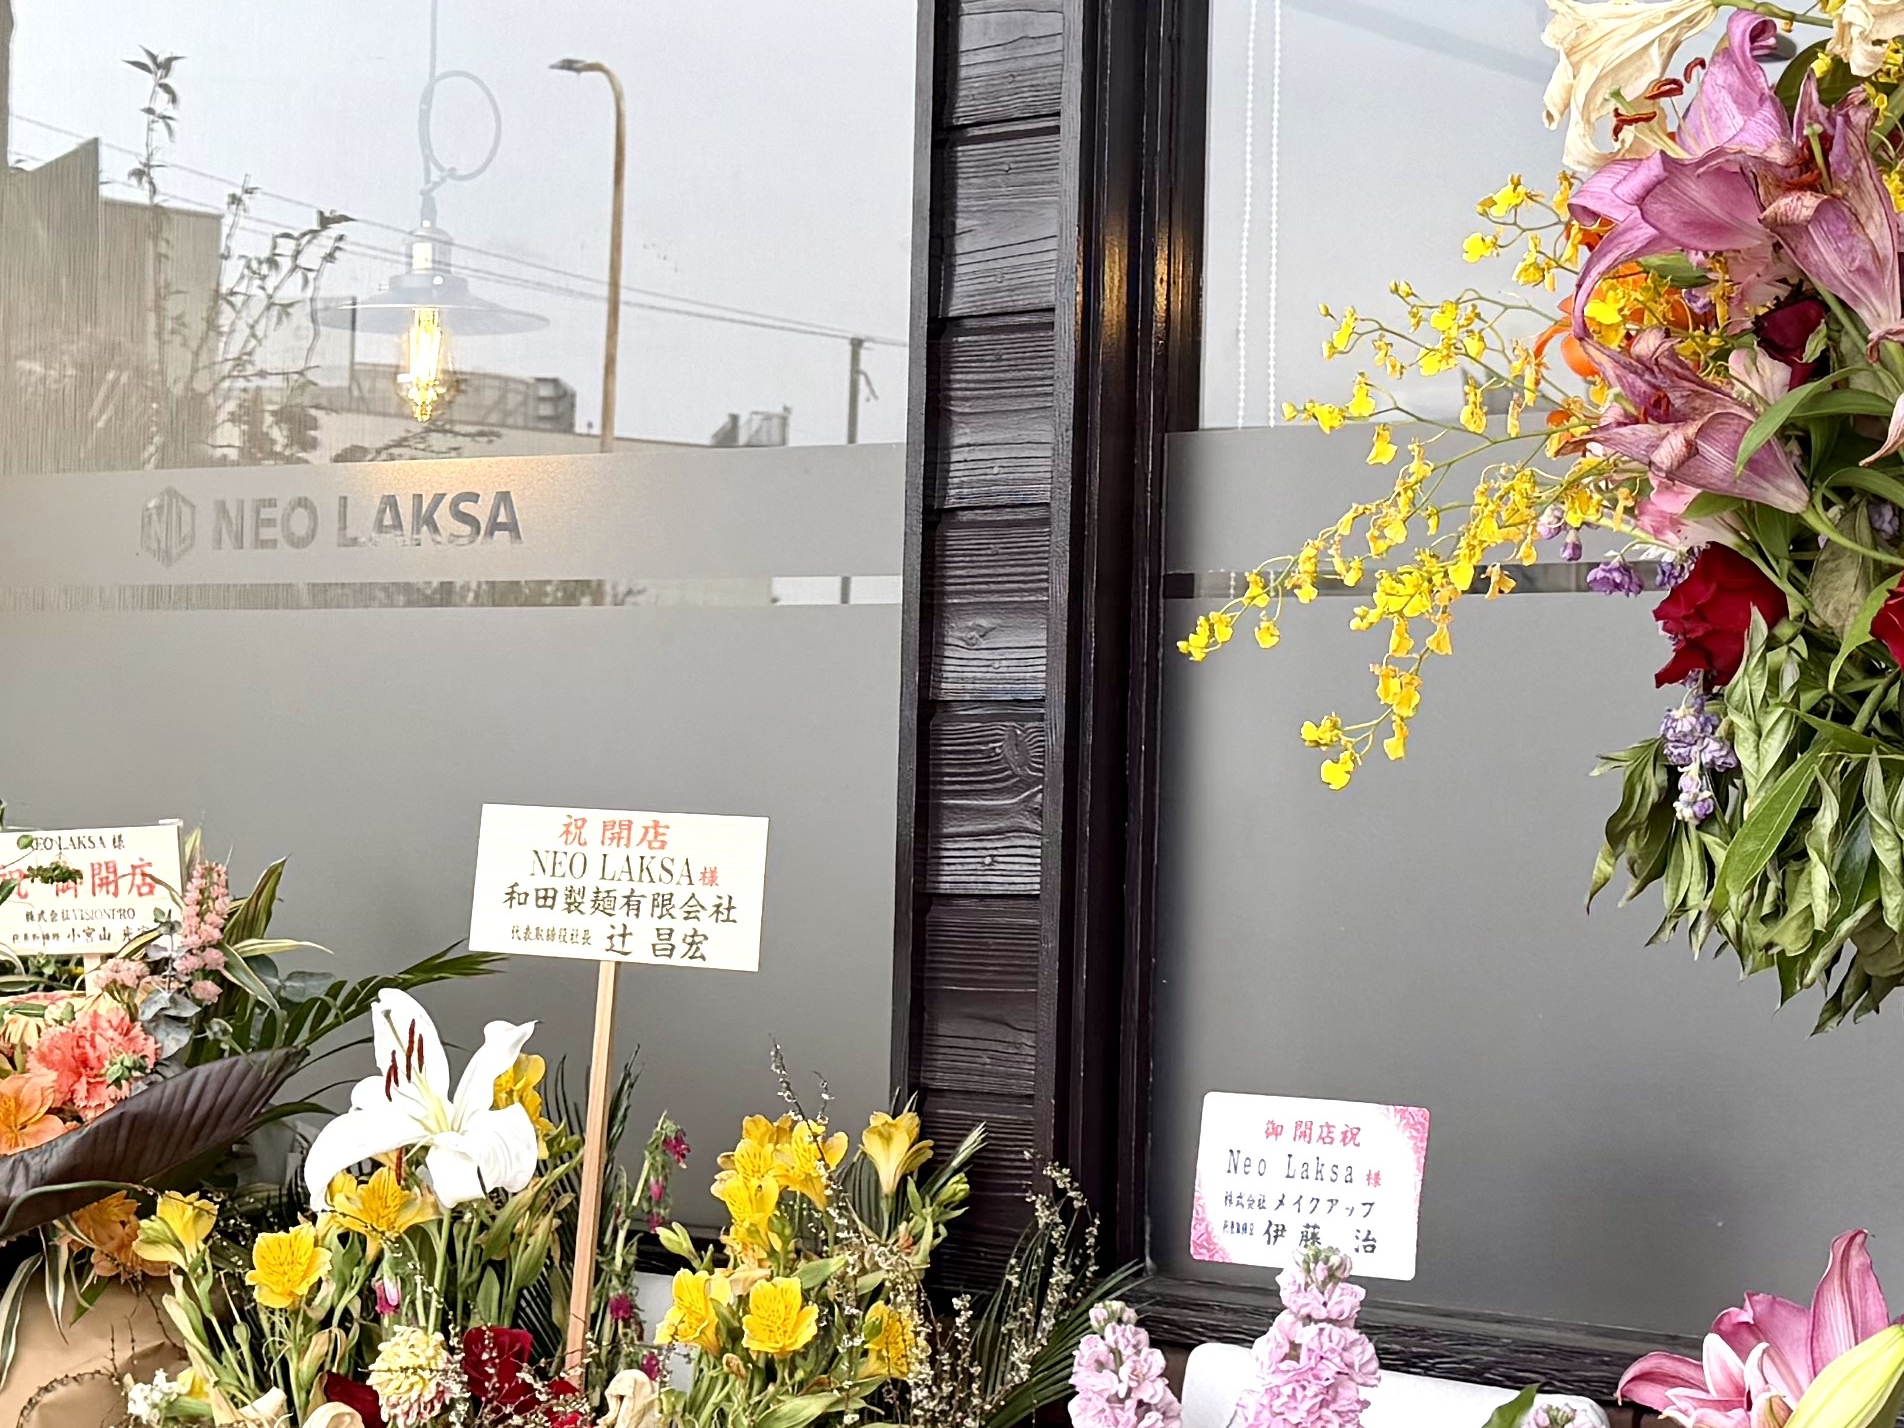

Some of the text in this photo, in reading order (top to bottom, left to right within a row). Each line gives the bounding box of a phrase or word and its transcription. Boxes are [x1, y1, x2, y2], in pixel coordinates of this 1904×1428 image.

[211, 490, 523, 551] NEO LAKSA
[559, 814, 671, 851] 祝開店
[530, 850, 720, 888] NEO LAKSA 様
[1265, 1119, 1362, 1148] 御開店祝
[1227, 1149, 1267, 1177] Neo
[1285, 1153, 1354, 1184] Laksa
[1354, 1228, 1378, 1254] 治
